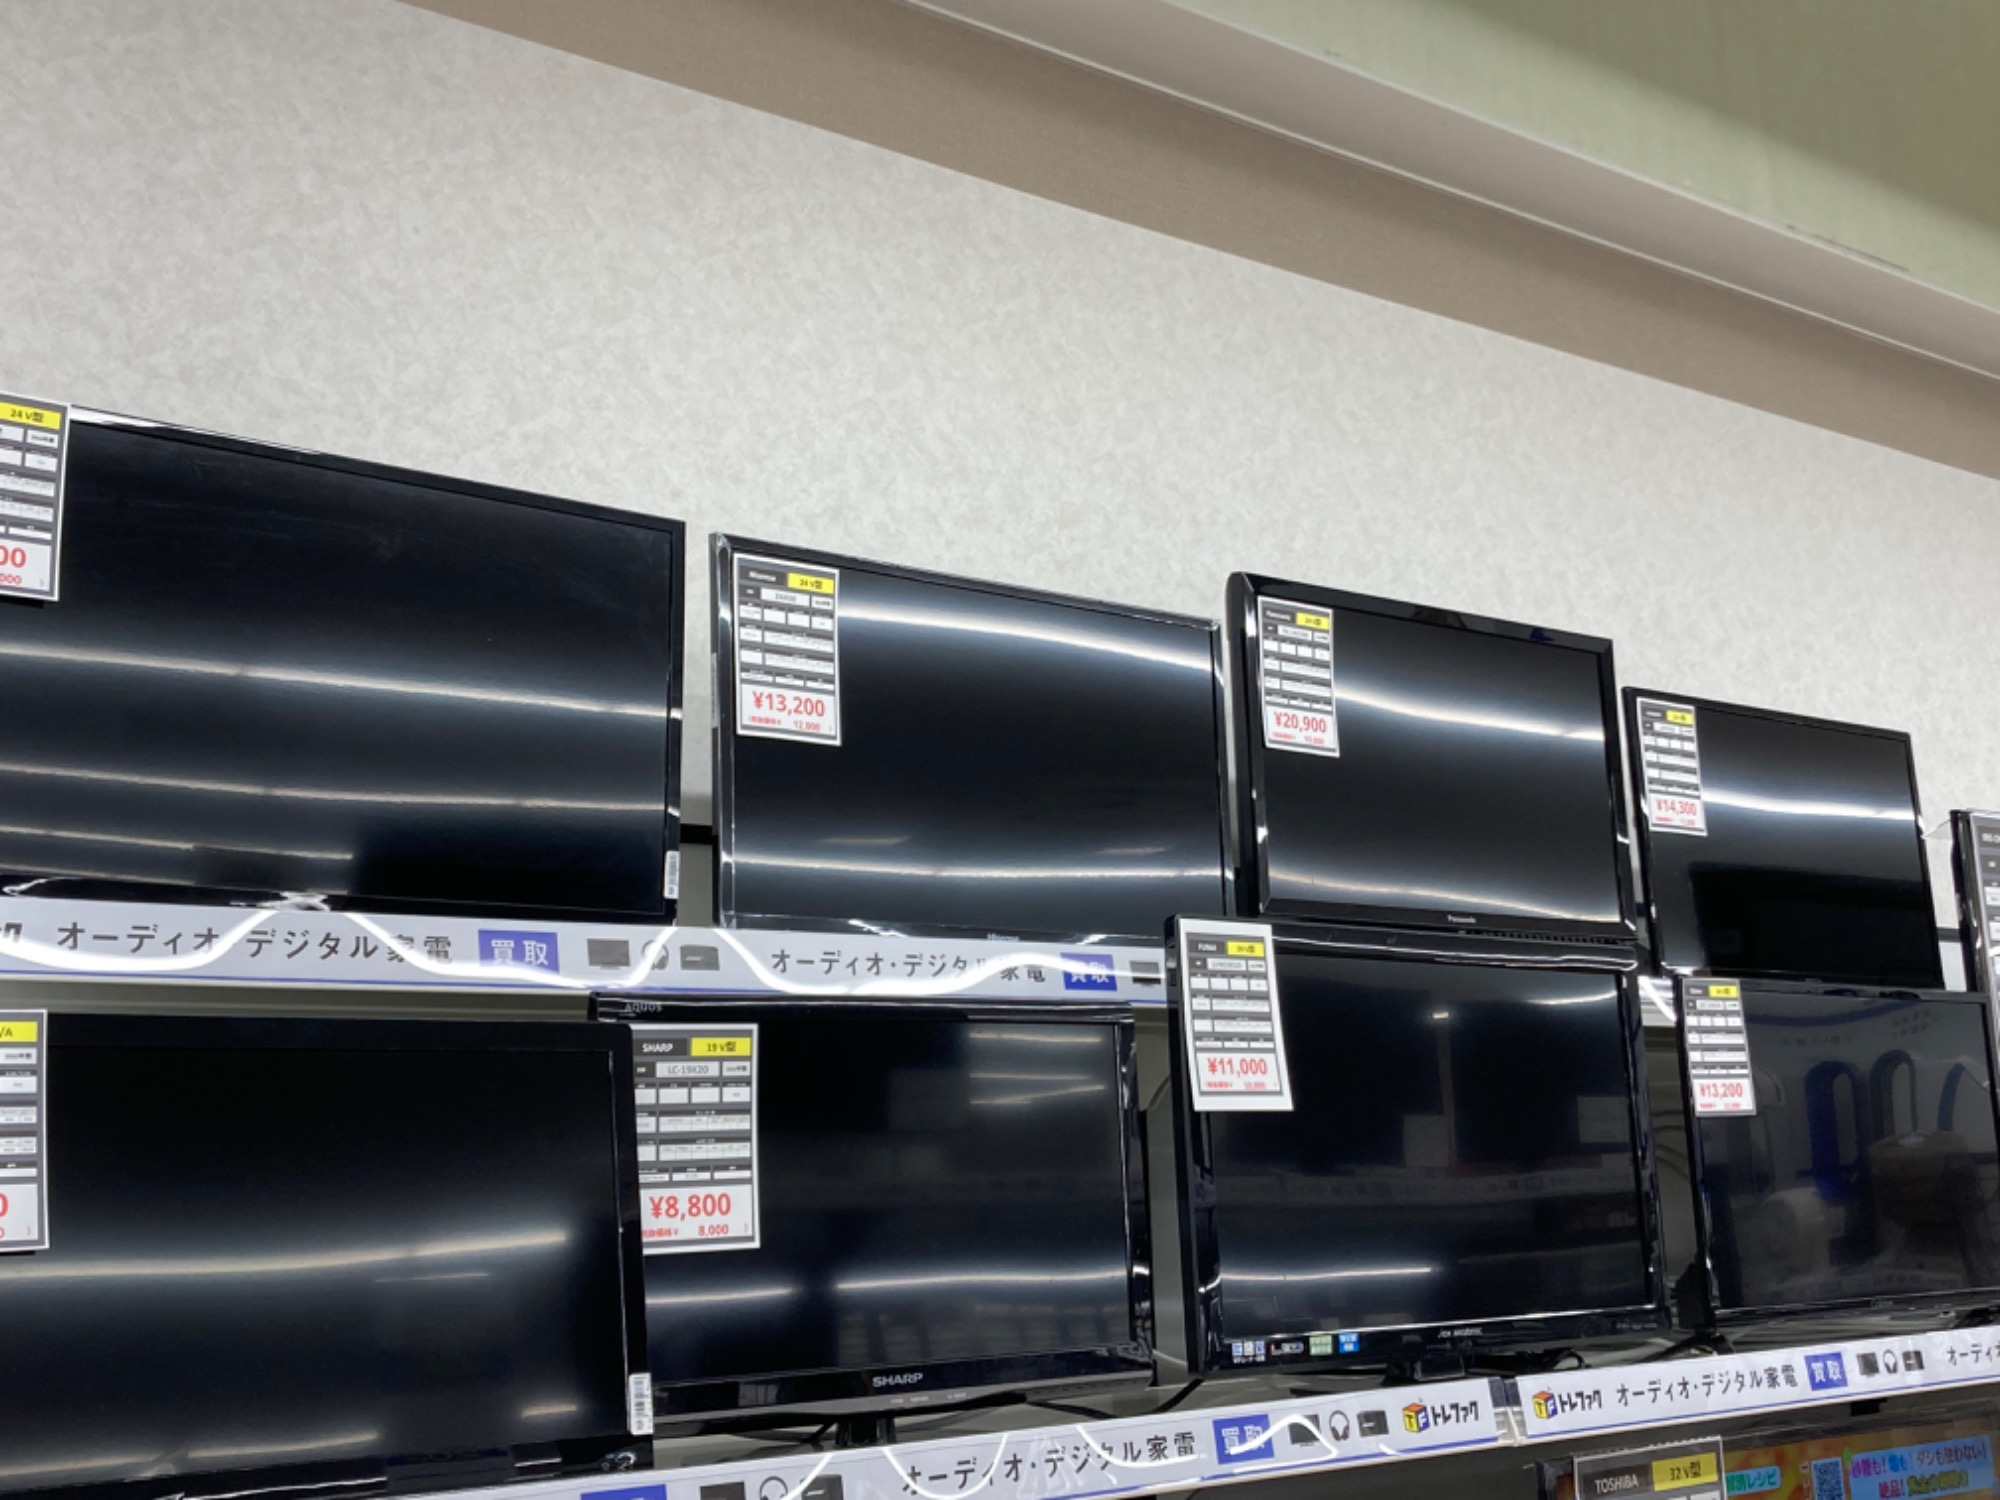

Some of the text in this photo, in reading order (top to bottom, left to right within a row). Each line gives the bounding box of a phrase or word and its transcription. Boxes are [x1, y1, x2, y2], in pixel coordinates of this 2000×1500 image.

[752, 691, 825, 718] ¥13,200
[1273, 711, 1327, 734] ¥20,900
[491, 939, 549, 967] 買取
[642, 1042, 674, 1053] SHARP
[1207, 1057, 1268, 1078] ¥11,000
[649, 1192, 732, 1222] ¥8,800
[698, 1223, 729, 1238] 8,000
[872, 1372, 924, 1388] SHARP
[1811, 1360, 1842, 1384] 買取
[1616, 1364, 1799, 1408] オーディオ・デジタル家電
[1558, 1389, 1603, 1414] トレファク
[1430, 1400, 1479, 1427] トレファク
[1595, 1473, 1639, 1495] TOSHIBA
[1669, 1466, 1682, 1481] 32
